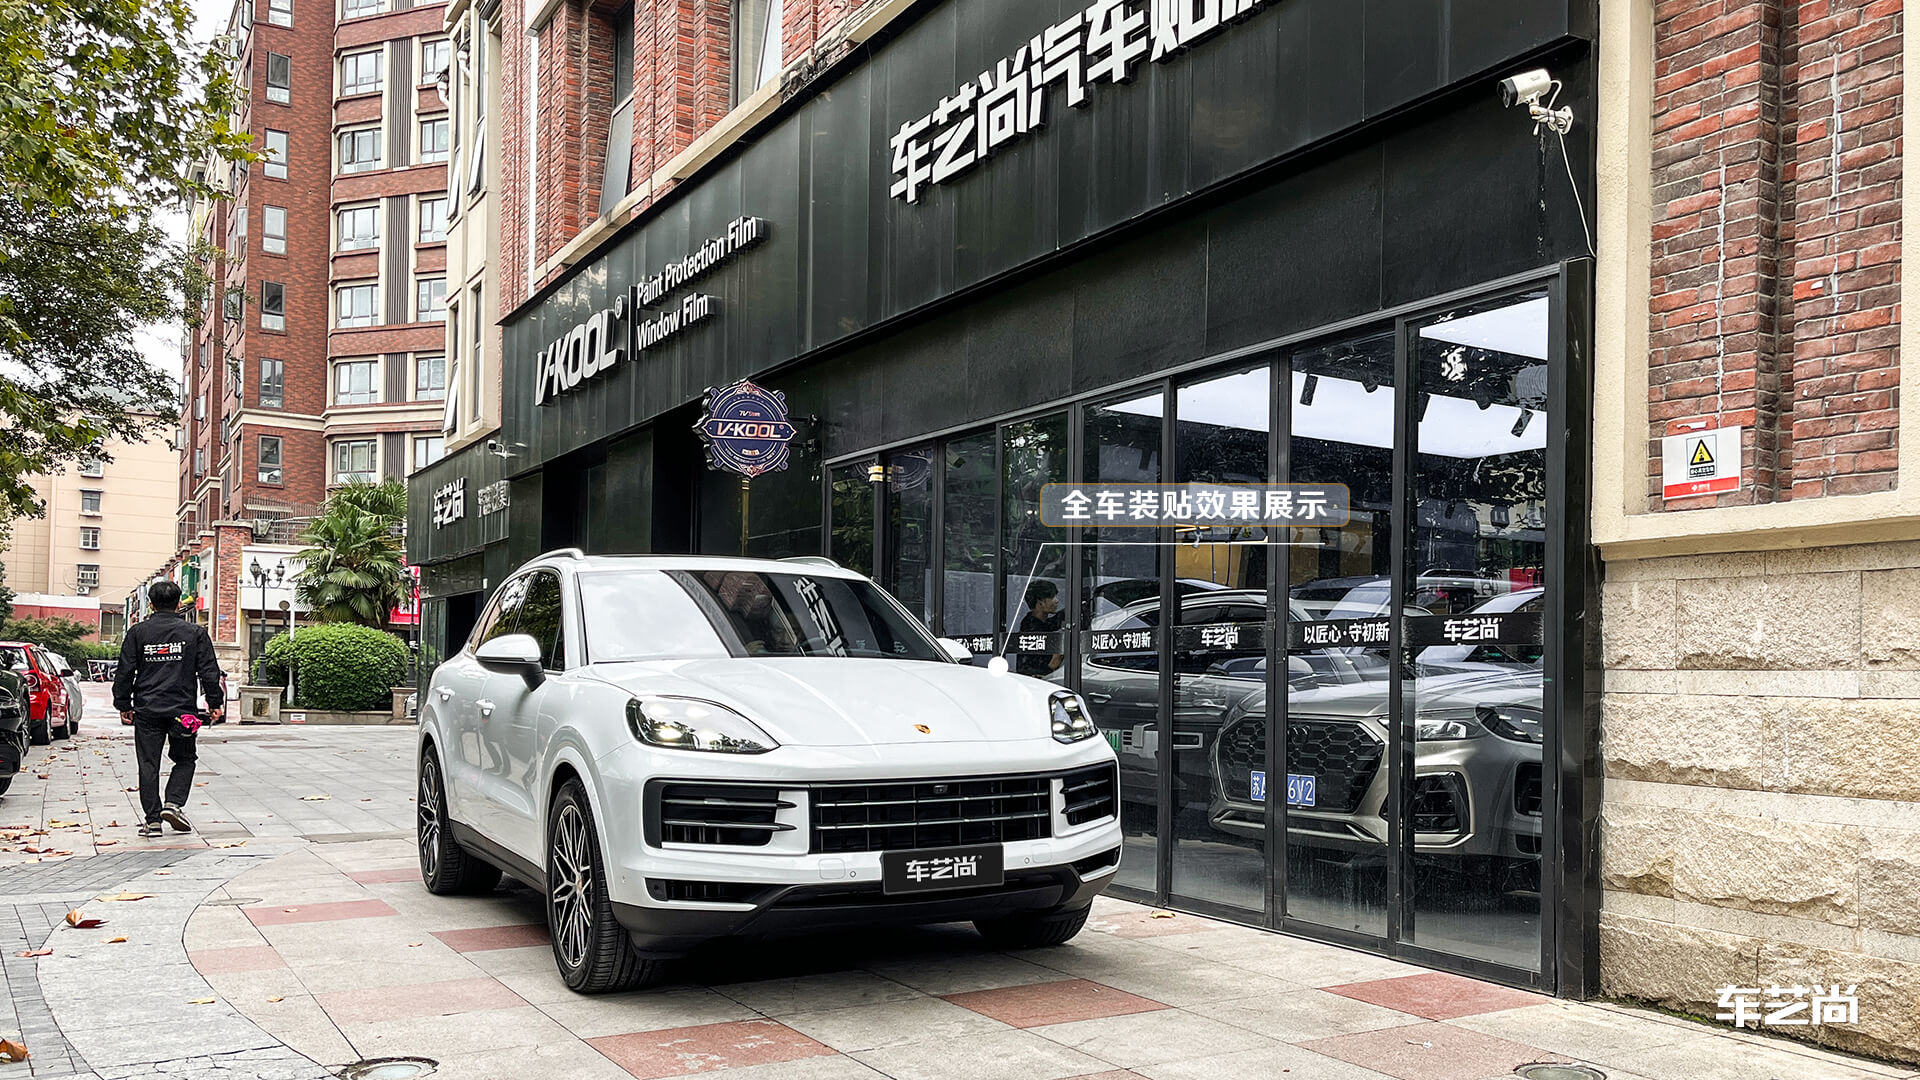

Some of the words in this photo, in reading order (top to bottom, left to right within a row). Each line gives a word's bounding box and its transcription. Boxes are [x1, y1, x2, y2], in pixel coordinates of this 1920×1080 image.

[637, 272, 663, 309] Paint
[665, 237, 724, 292] Protection
[728, 216, 756, 253] Film
[637, 309, 680, 351] Window
[682, 292, 708, 327] Film
[433, 477, 464, 530] 车艺尚
[1201, 626, 1239, 647] 车艺尚
[1443, 617, 1500, 641] 车艺尚
[1018, 635, 1046, 651] 车艺尚
[906, 855, 977, 882] 车艺尚
